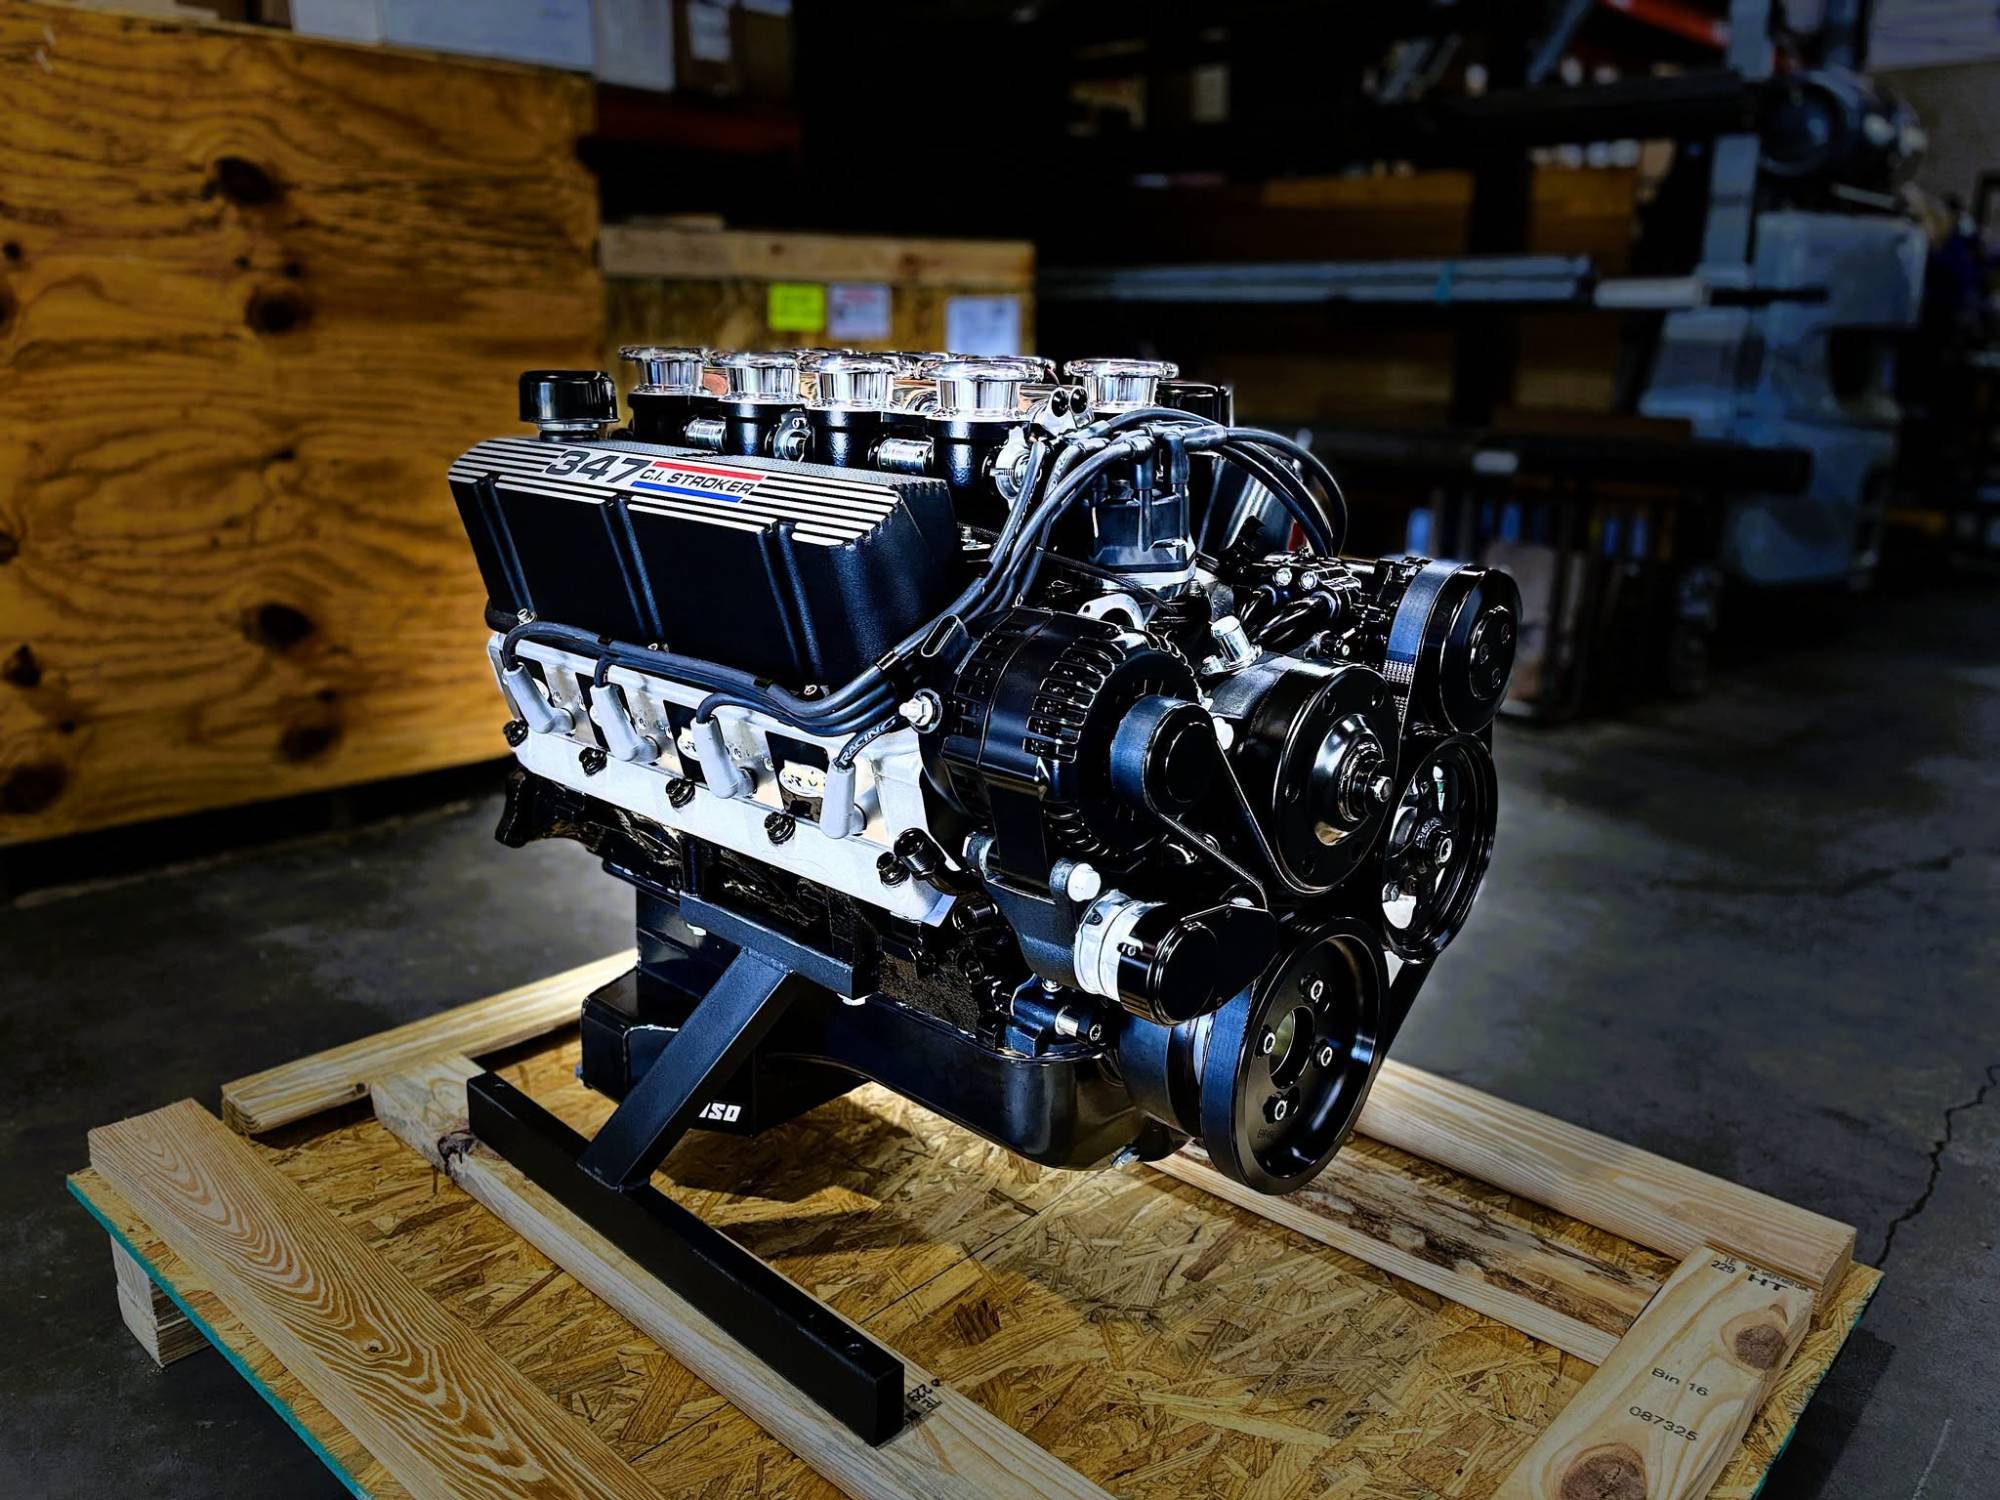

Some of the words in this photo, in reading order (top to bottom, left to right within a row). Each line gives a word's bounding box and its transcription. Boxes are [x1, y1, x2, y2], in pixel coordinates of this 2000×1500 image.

[545, 450, 652, 484] 347
[639, 469, 664, 482] C.I.
[667, 472, 756, 494] STROKER
[839, 715, 896, 766] RACING
[1711, 1260, 1737, 1275] 229
[1747, 1273, 1789, 1292] HT
[1651, 1367, 1680, 1385] Bin
[1688, 1382, 1710, 1397] 16
[1628, 1405, 1699, 1442] 087325
